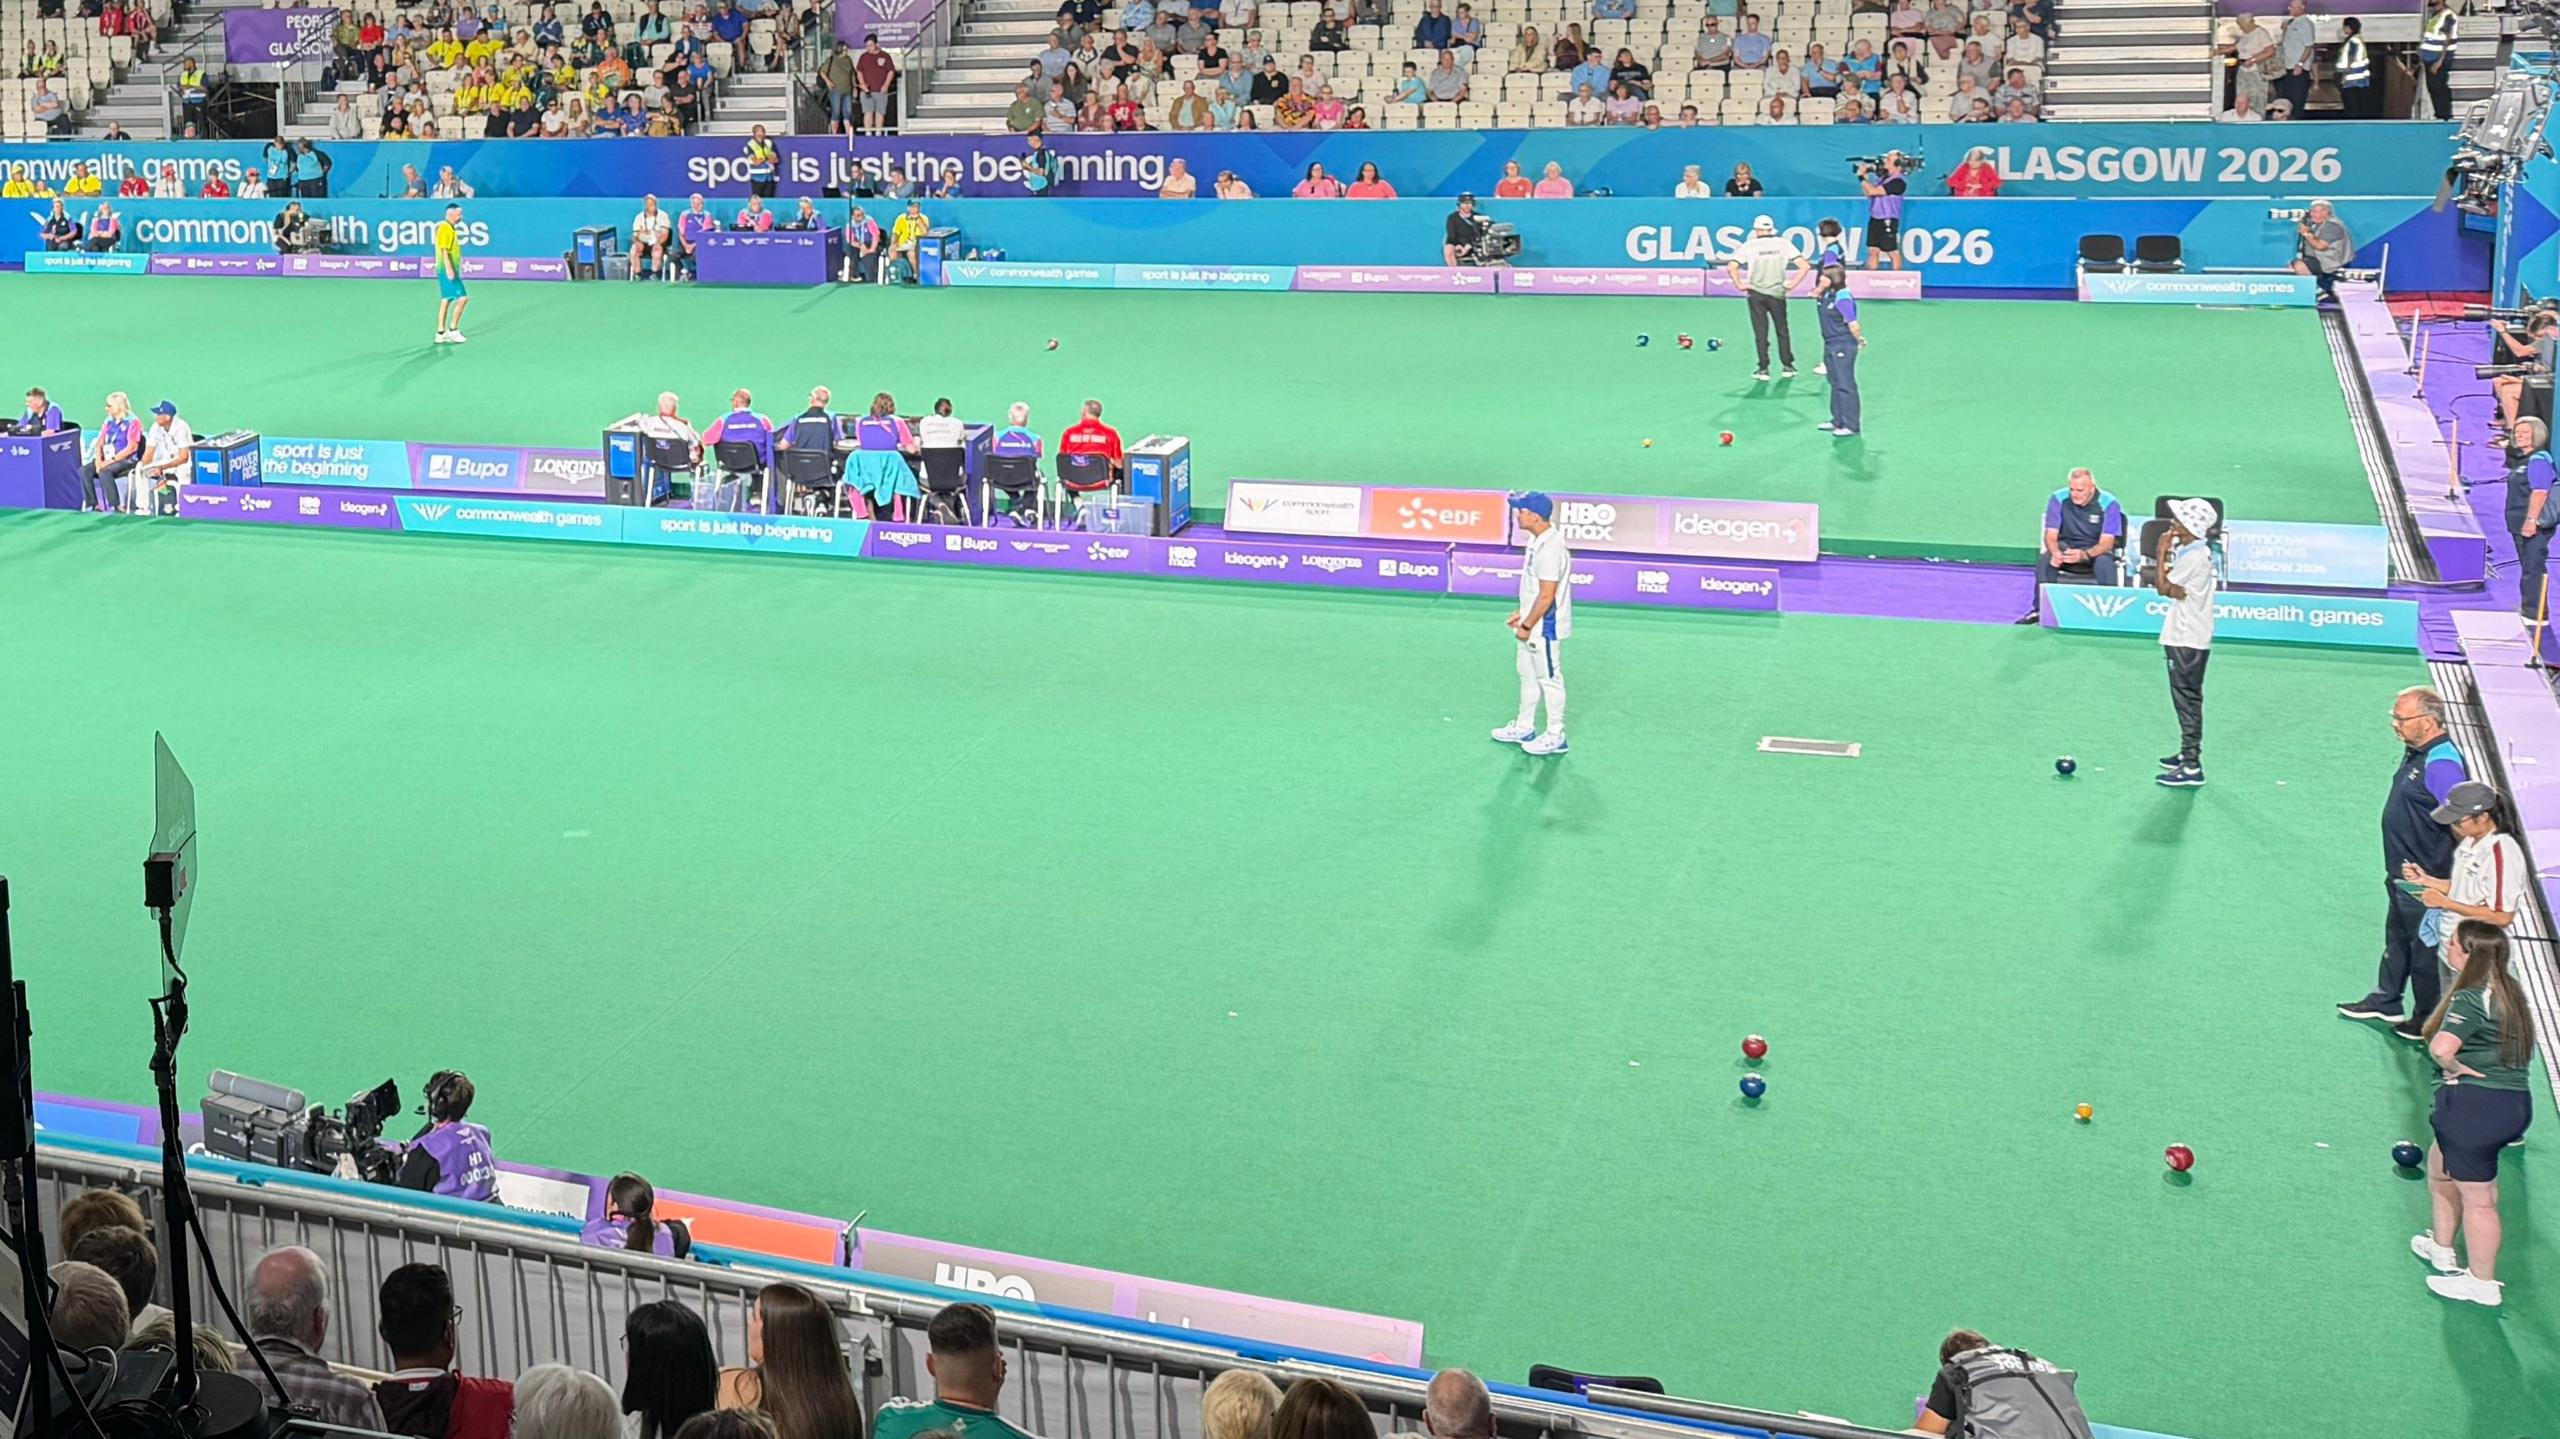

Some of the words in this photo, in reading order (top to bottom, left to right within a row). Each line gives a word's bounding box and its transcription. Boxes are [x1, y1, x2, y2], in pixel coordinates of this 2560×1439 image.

[791, 152, 820, 182] is
[827, 152, 894, 189] just
[904, 151, 964, 182] the
[2217, 147, 2343, 183] 2026
[1877, 228, 1994, 265] 026
[2145, 281, 2246, 294] commonwealth
[2249, 282, 2295, 295] games
[272, 444, 314, 460] sport
[318, 444, 332, 459] is
[333, 444, 364, 462] just
[263, 458, 288, 474] the
[291, 460, 369, 481] beginning
[455, 458, 509, 480] Bupa
[1282, 500, 1354, 510] commonwealth
[1560, 502, 1617, 526] HBO
[455, 508, 554, 524] commonwealth
[556, 512, 602, 527] games
[660, 518, 696, 536] sport
[699, 519, 711, 533] is
[712, 519, 738, 537] just
[739, 521, 761, 536] the
[764, 523, 833, 544] beginning
[1558, 525, 1614, 541] max
[963, 537, 998, 552] Bupa
[1399, 563, 1439, 577] Bupa
[2309, 606, 2385, 628] games
